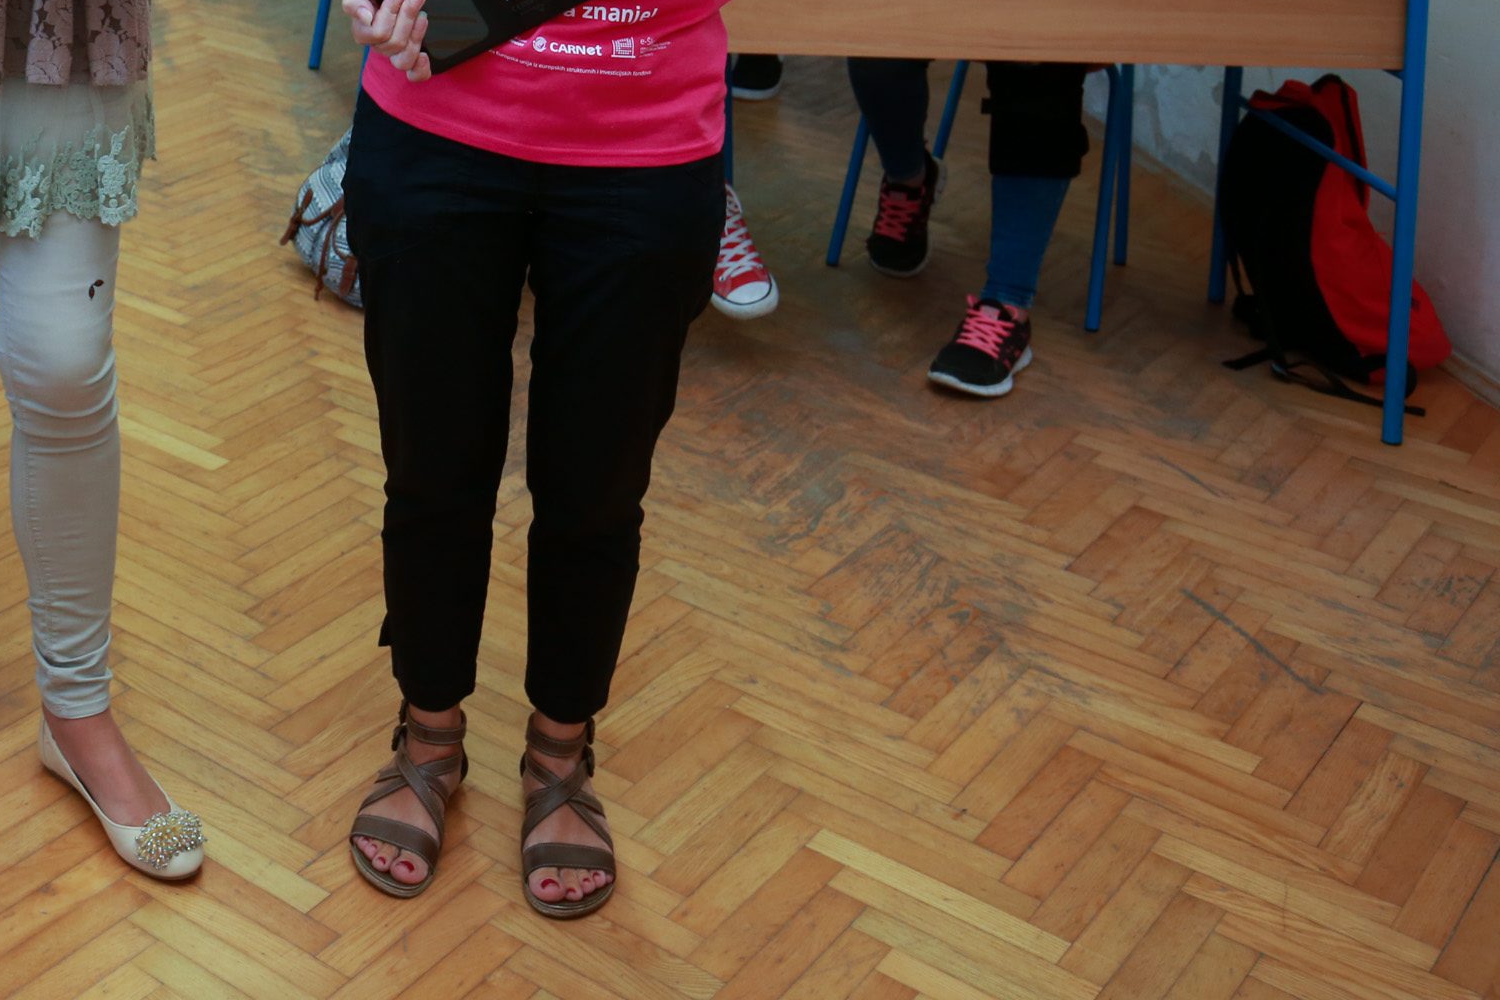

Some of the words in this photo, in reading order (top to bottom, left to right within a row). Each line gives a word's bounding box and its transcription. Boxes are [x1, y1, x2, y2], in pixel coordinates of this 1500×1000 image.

[549, 42, 602, 57] CARNet
[538, 64, 565, 72] europskih
[566, 66, 596, 75] strukturnih
